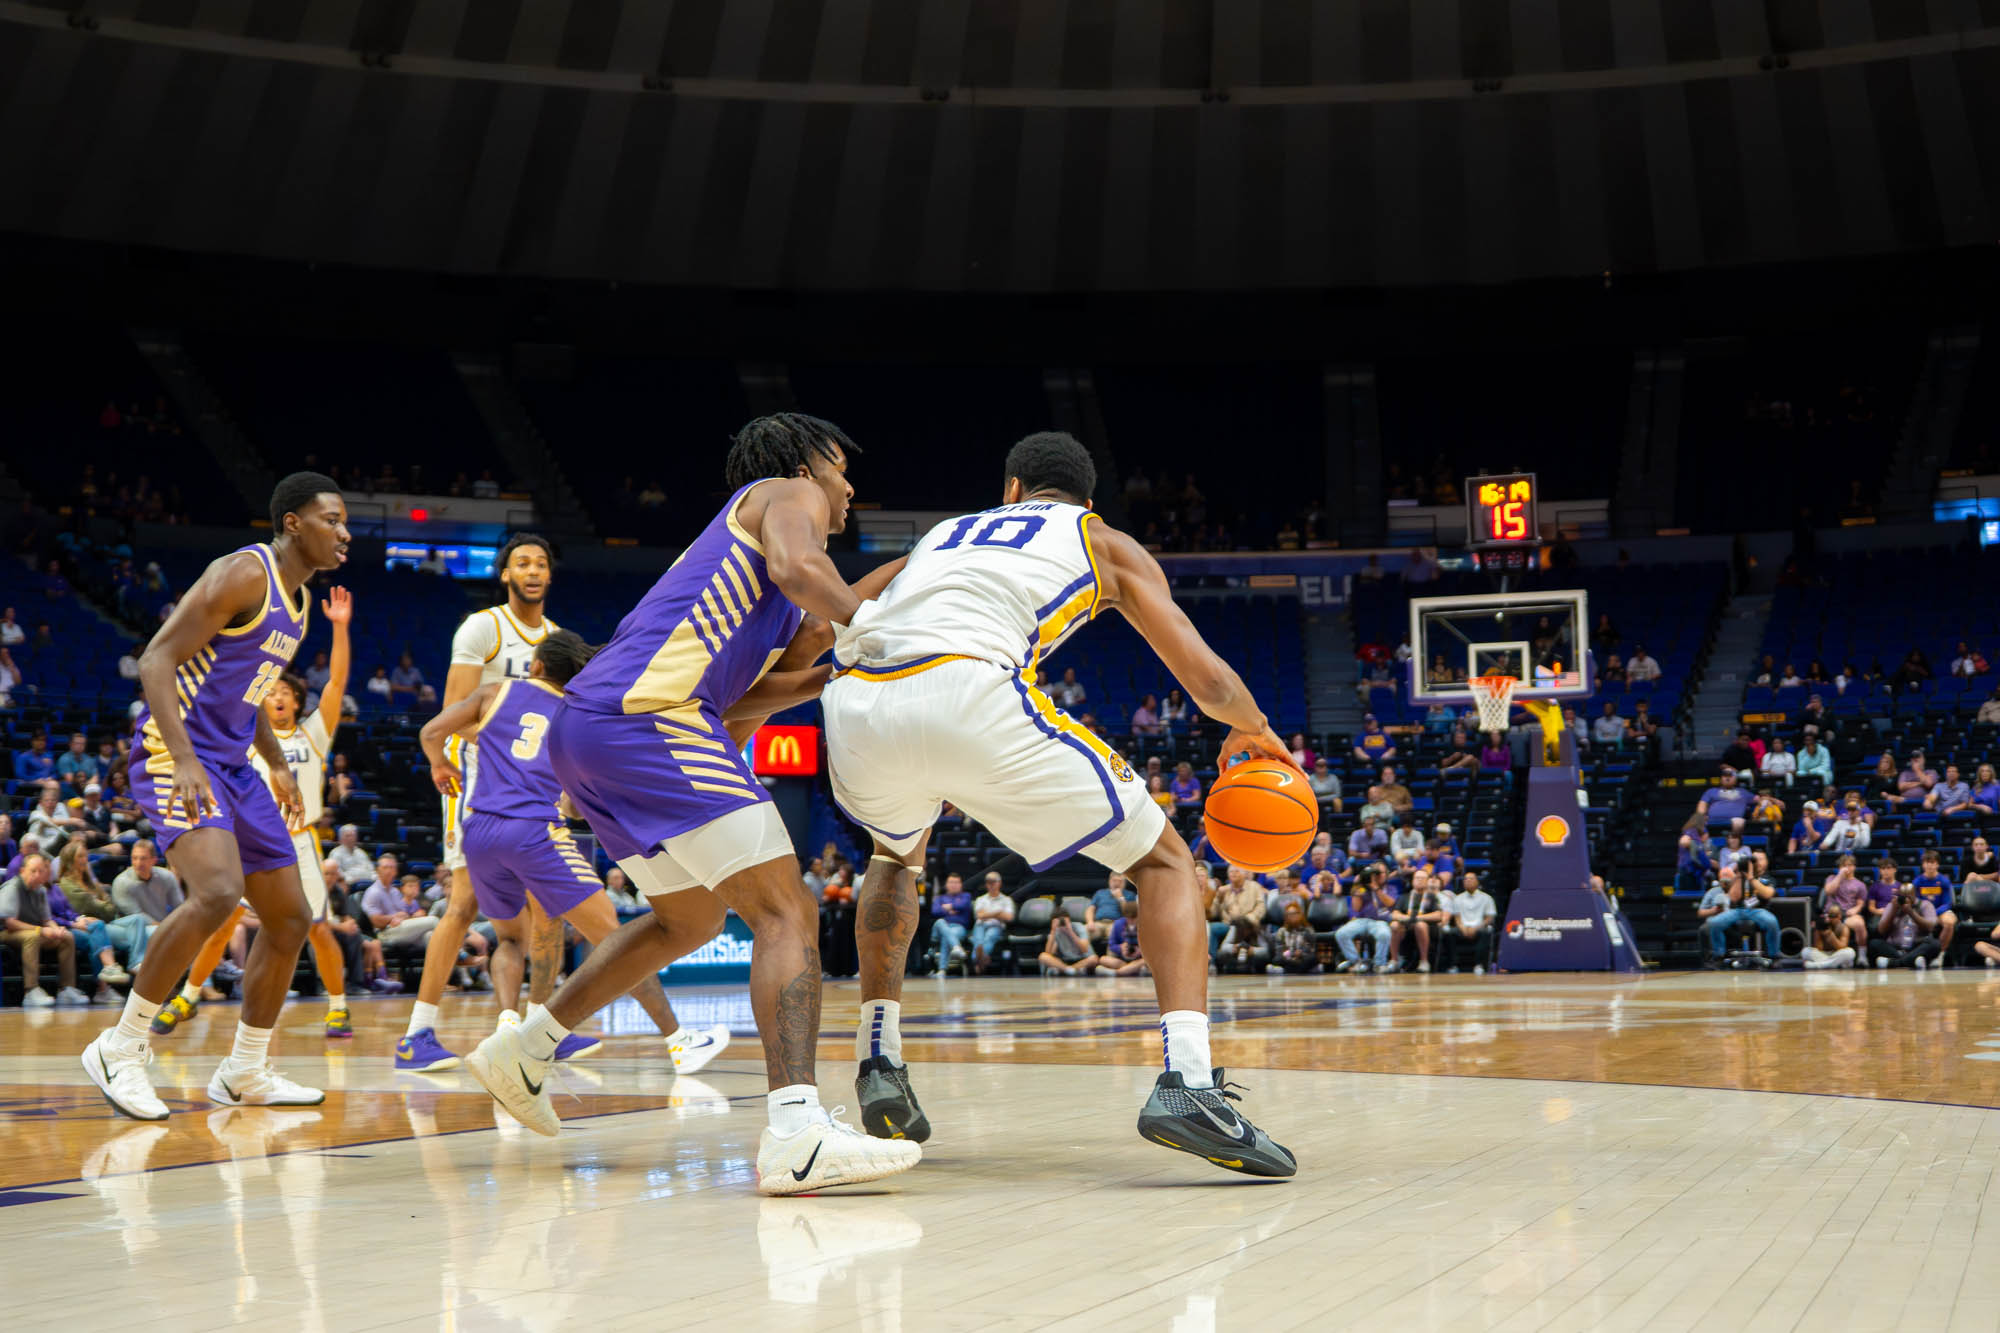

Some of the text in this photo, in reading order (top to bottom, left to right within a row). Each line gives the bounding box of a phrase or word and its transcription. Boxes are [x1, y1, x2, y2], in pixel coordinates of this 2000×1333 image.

[932, 515, 1047, 551] 10
[1492, 502, 1527, 540] 15
[242, 660, 282, 707] 22
[511, 712, 550, 760] 3
[1523, 917, 1593, 931] Equipment
[1523, 928, 1562, 941] Share
